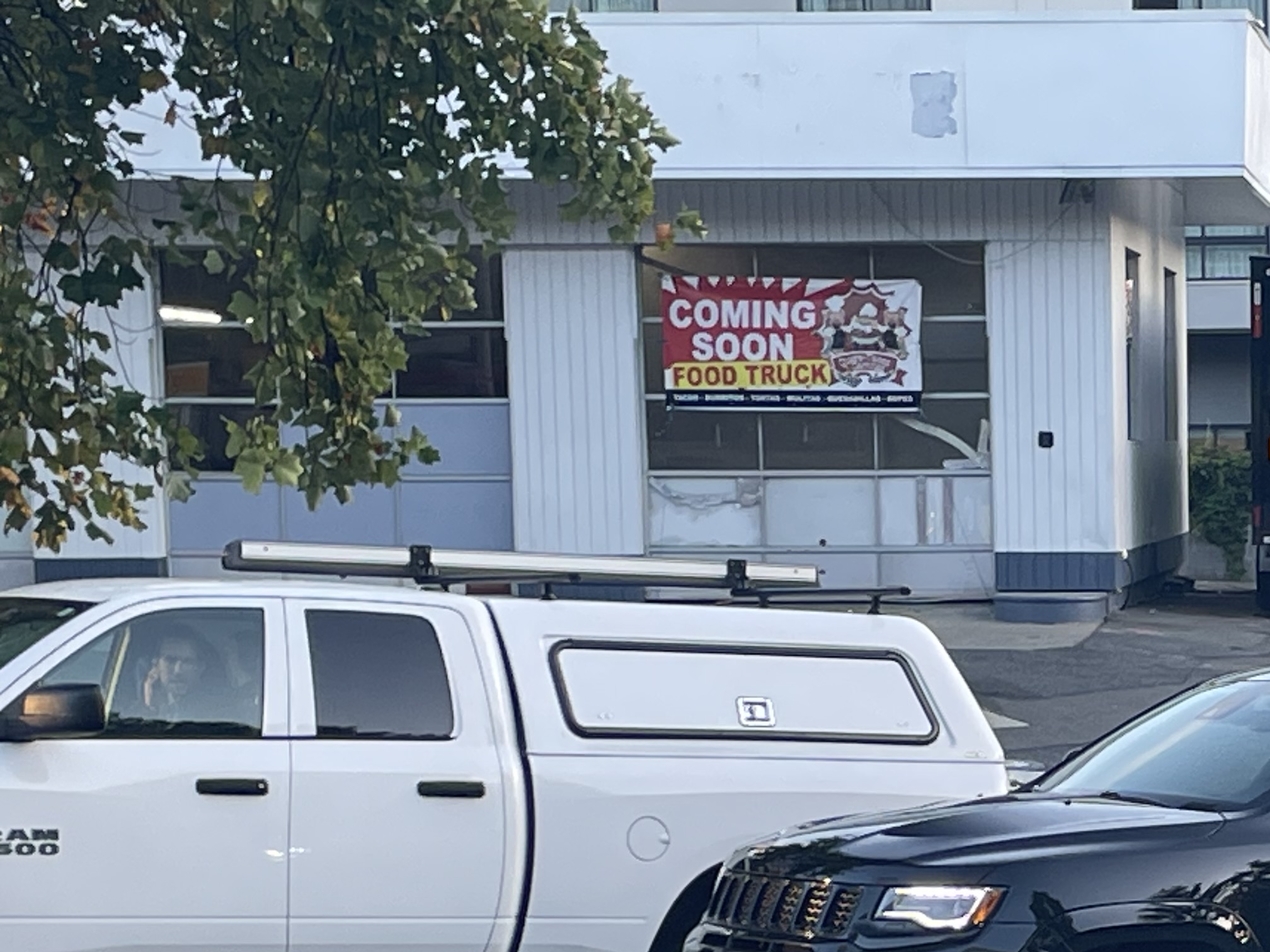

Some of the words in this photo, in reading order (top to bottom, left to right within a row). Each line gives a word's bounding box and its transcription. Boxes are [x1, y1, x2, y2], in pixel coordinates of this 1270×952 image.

[669, 299, 817, 329] COMING
[691, 332, 794, 361] SOON
[673, 366, 738, 387] FOOD
[745, 363, 830, 386] TRUCK
[0, 828, 59, 841] AM
